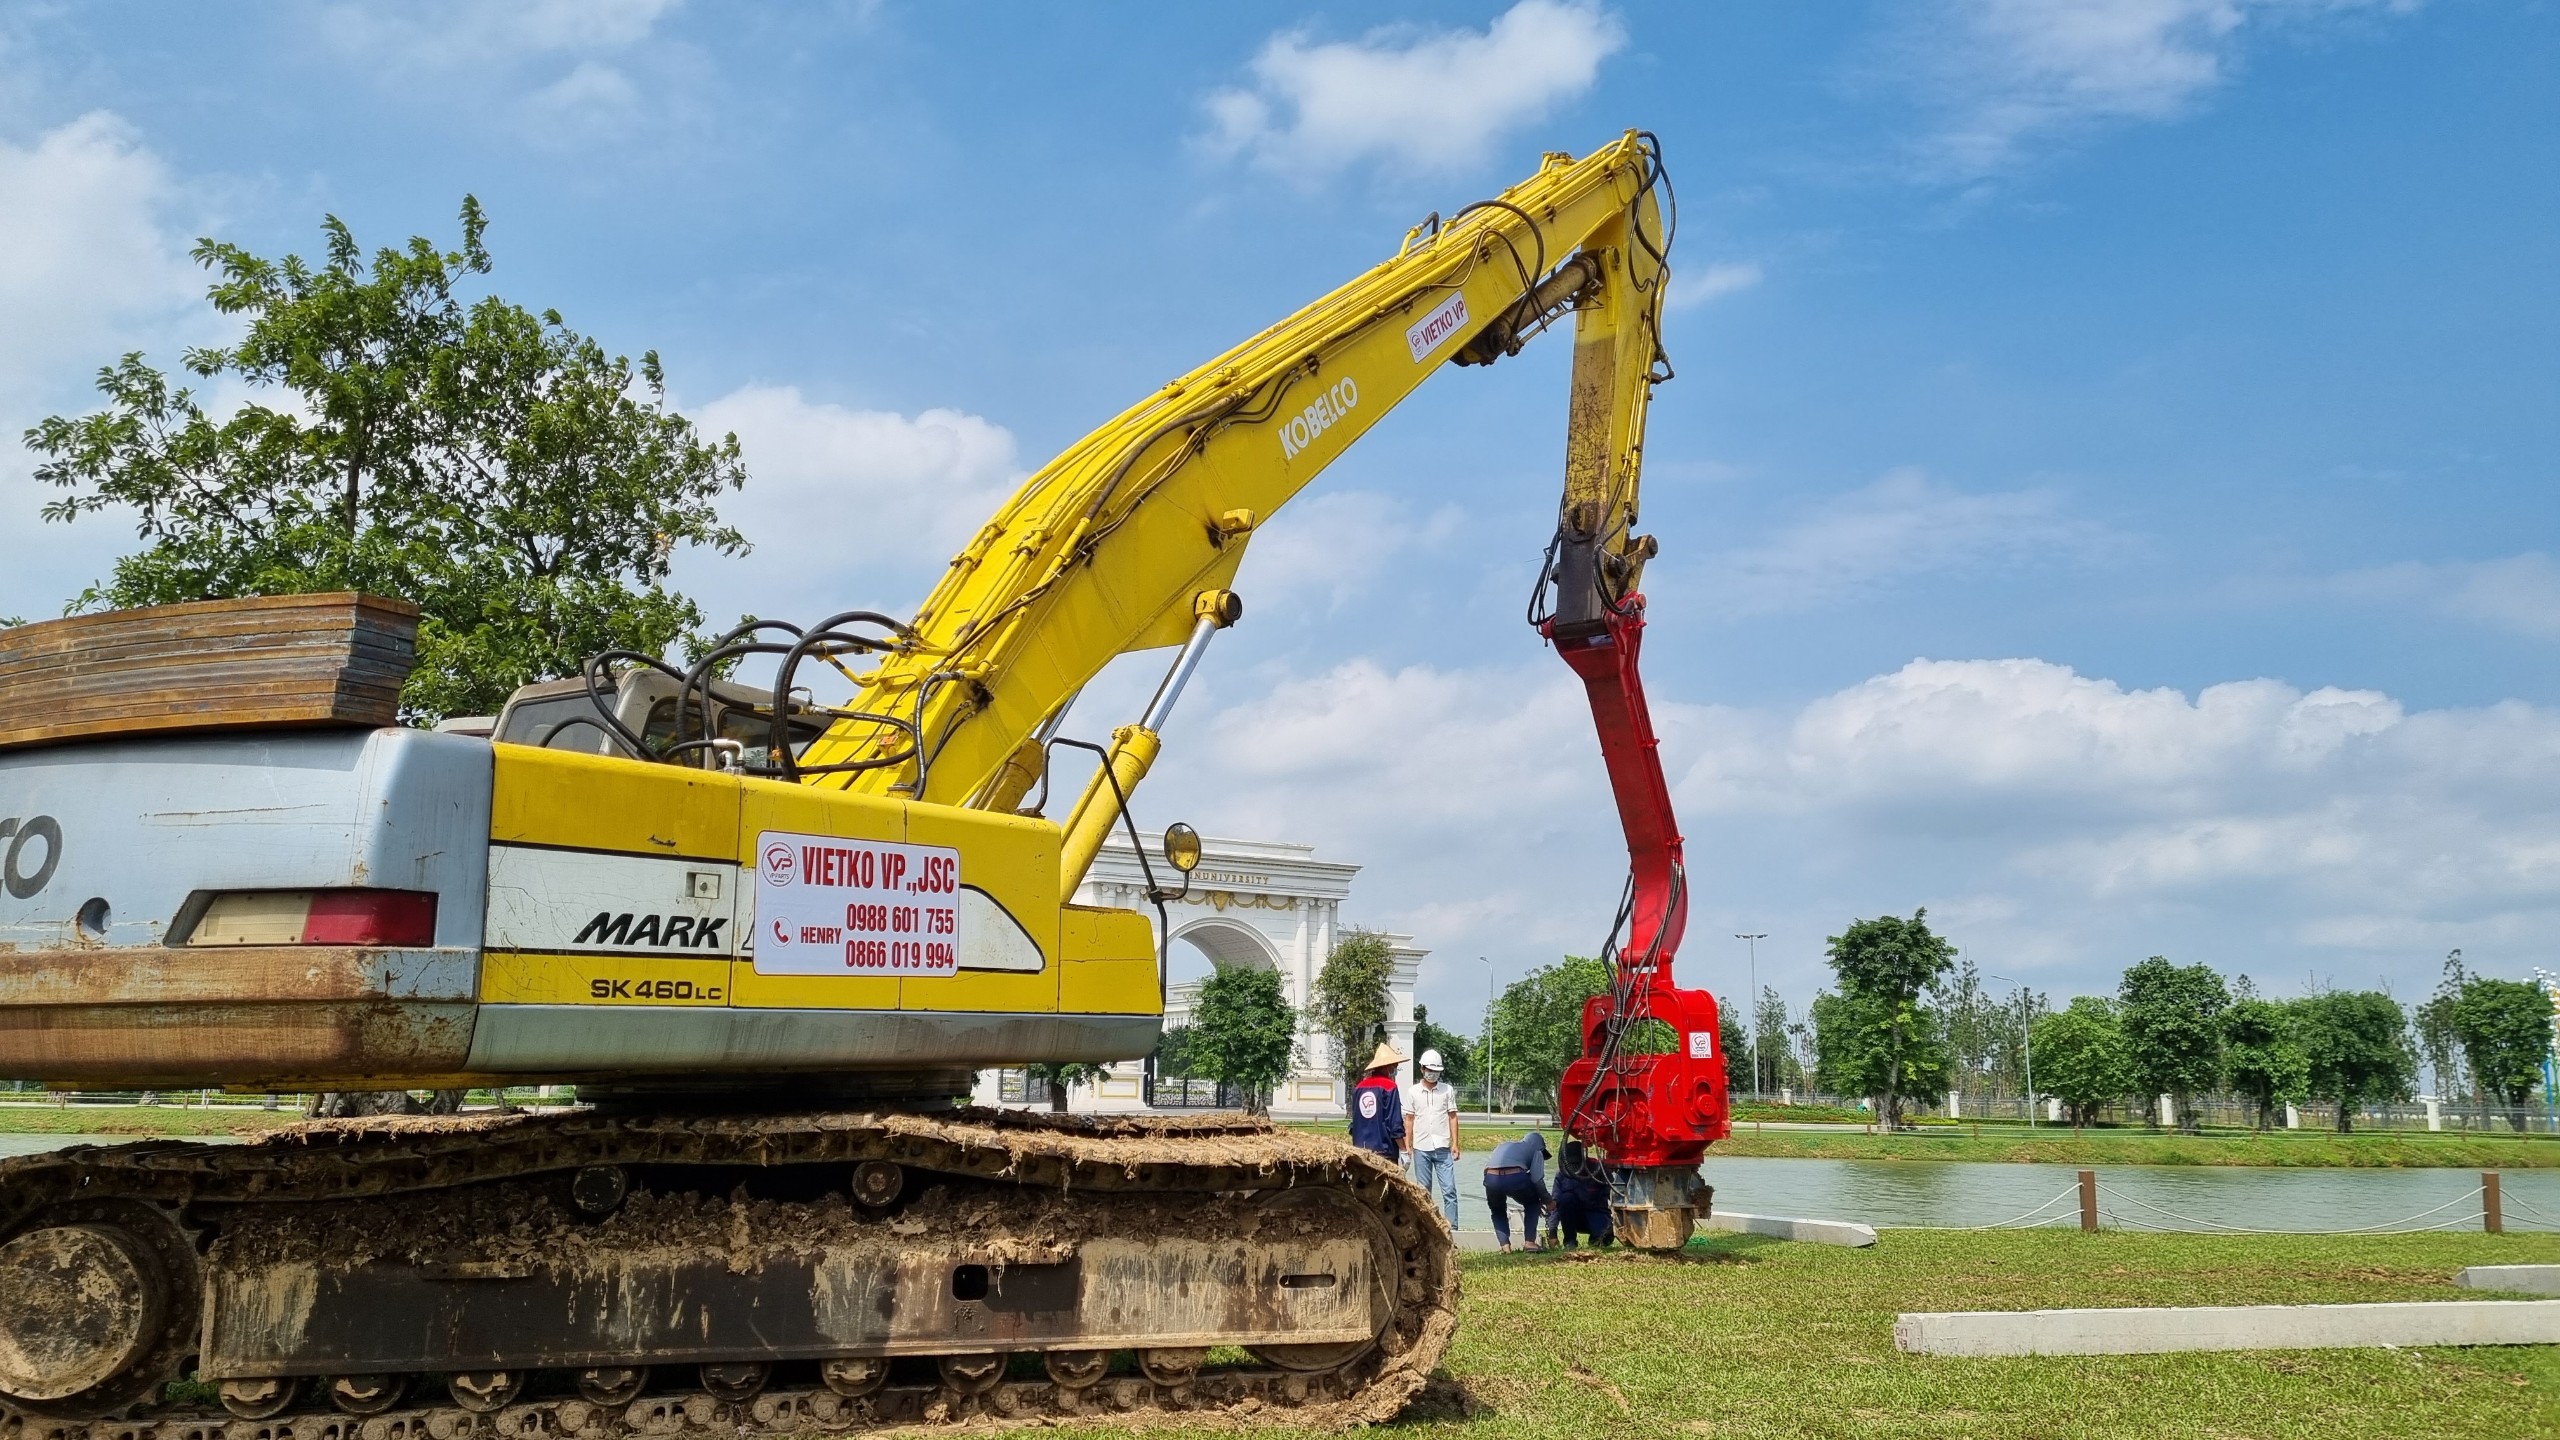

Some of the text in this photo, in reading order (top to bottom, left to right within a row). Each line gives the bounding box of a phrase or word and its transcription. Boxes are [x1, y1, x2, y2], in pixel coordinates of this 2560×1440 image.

[1421, 300, 1464, 346] VIETKO VP
[1278, 376, 1358, 461] KOBELCO
[802, 846, 874, 889] VIETKO
[1184, 871, 1269, 884] INUNIVERSITY
[572, 912, 729, 949] MARK
[801, 926, 842, 945] HENRY
[846, 903, 954, 935] 0988 601 755
[845, 940, 954, 969] 0866 019 994
